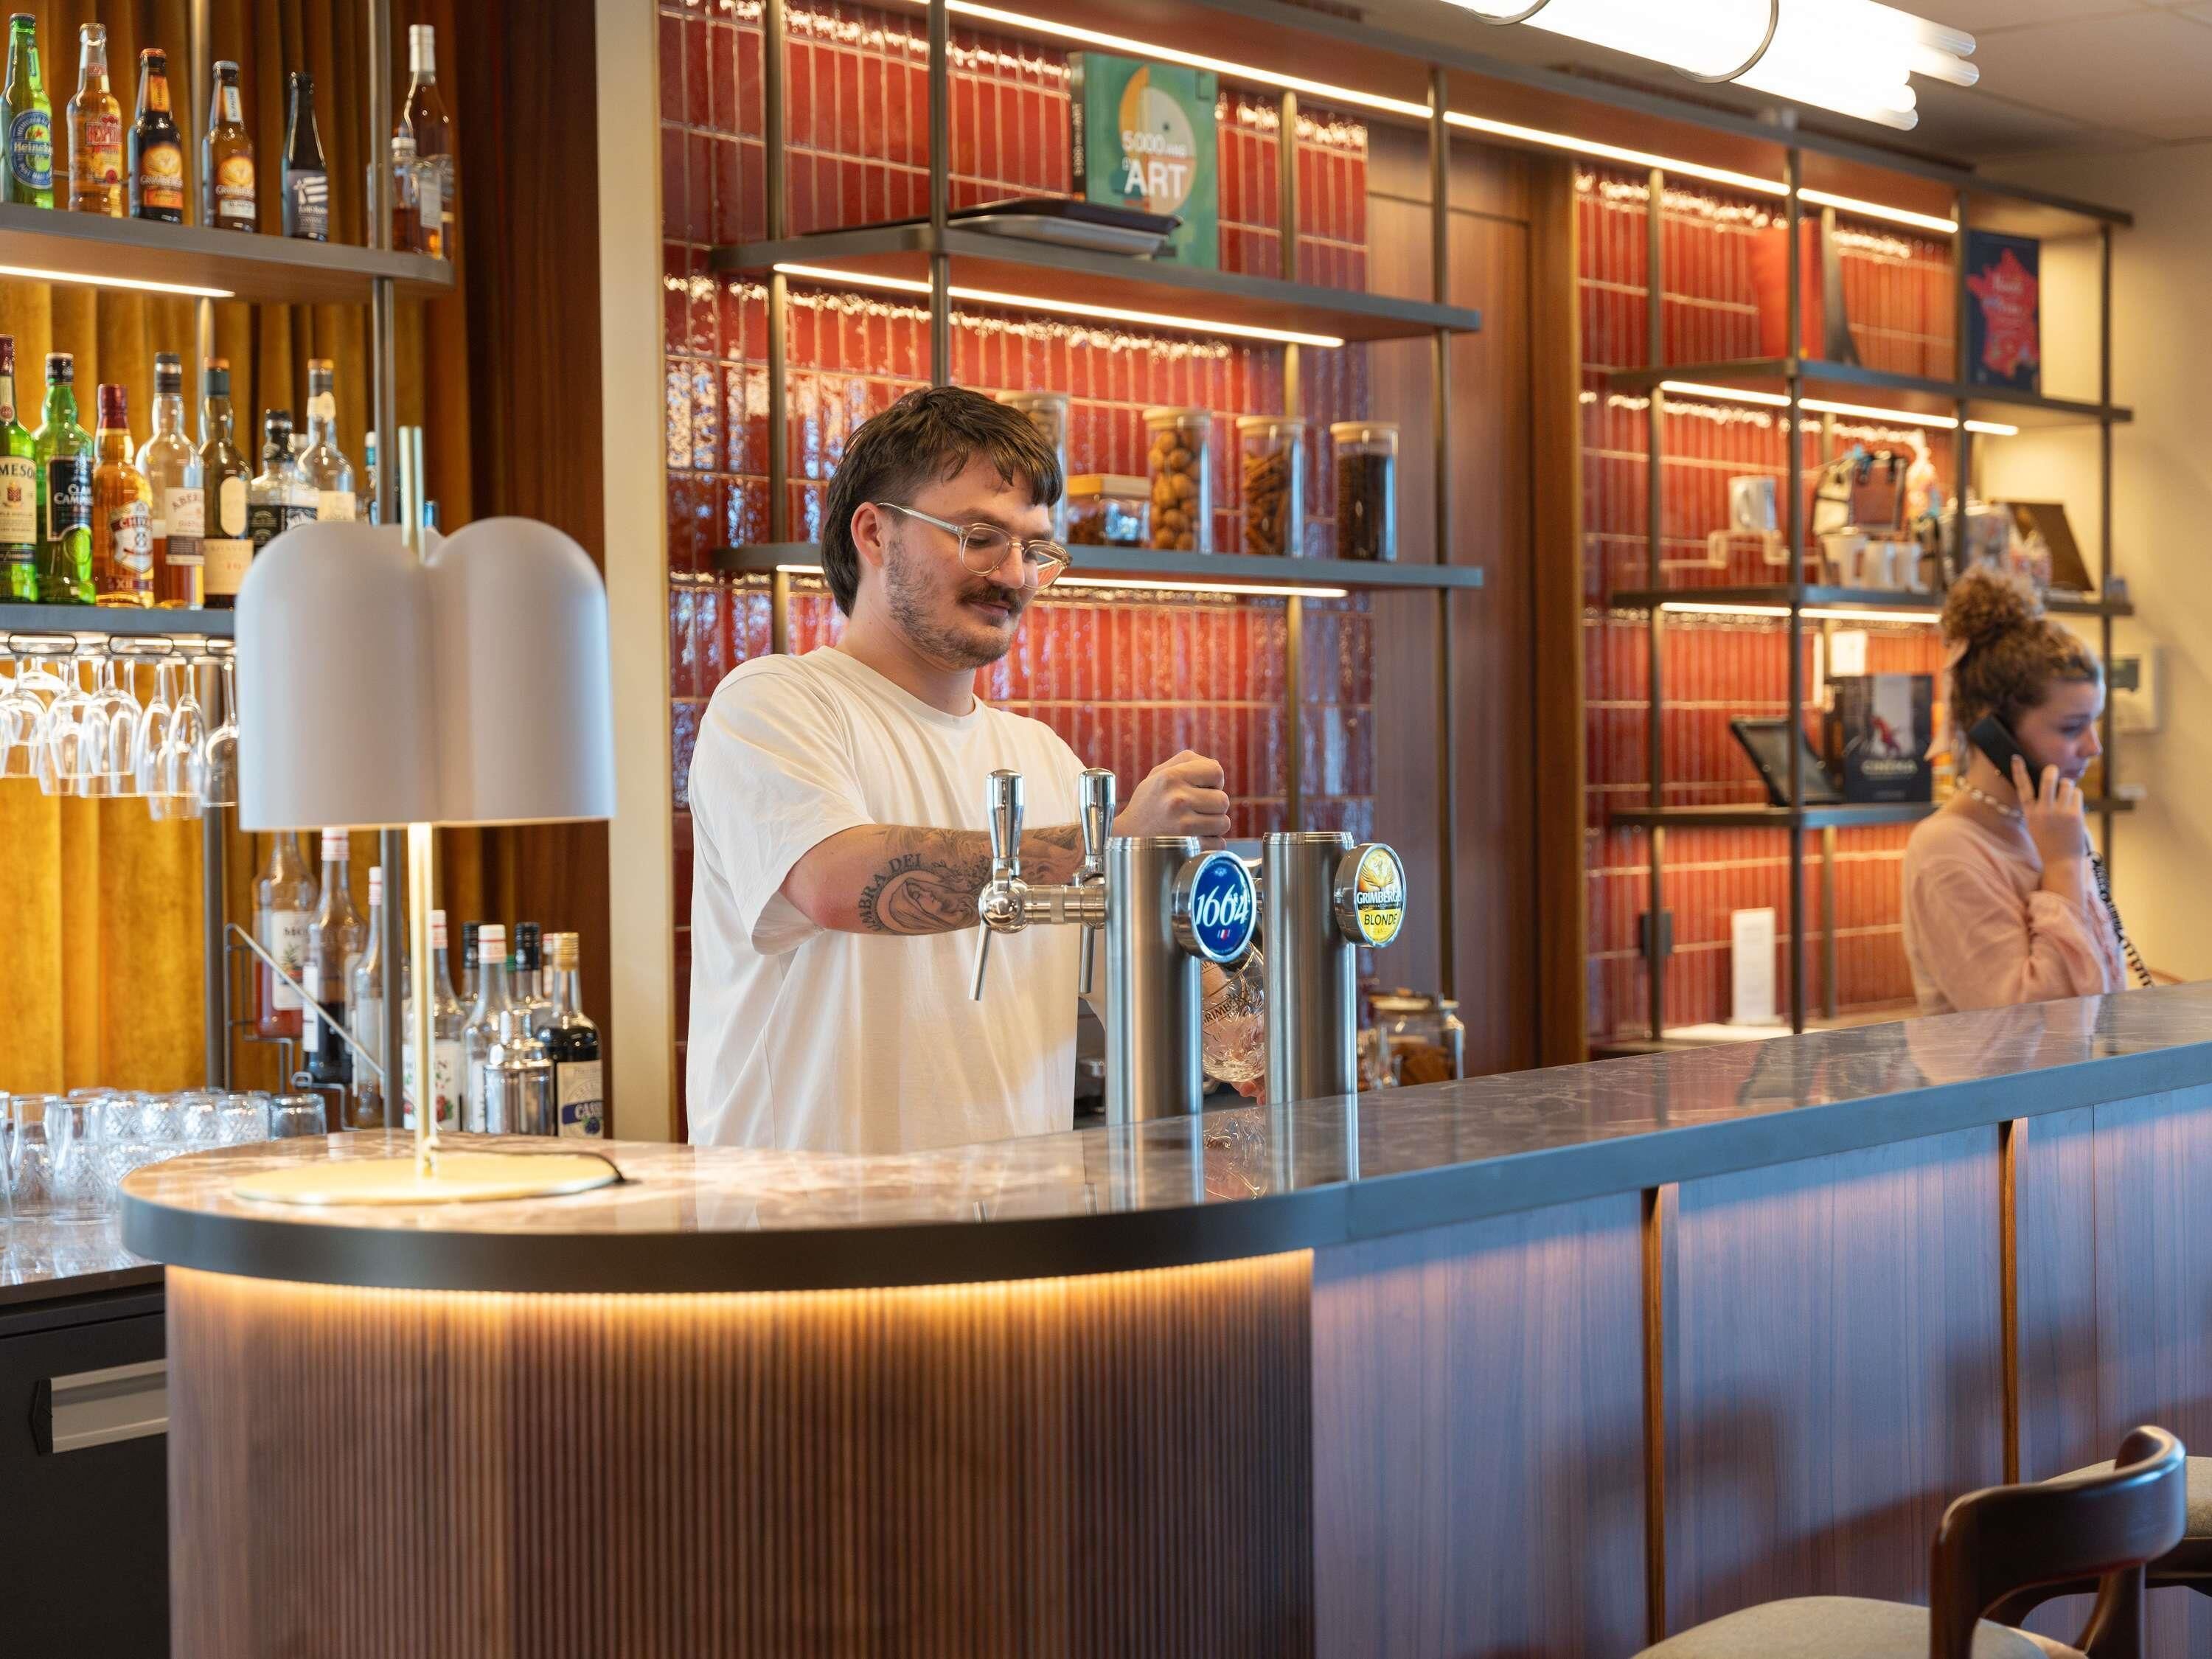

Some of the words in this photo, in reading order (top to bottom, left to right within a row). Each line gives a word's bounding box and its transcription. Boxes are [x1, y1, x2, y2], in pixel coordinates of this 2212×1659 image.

[888, 854, 922, 873] DEI
[1196, 884, 1249, 927] 1664
[1364, 914, 1398, 925] BLONDE
